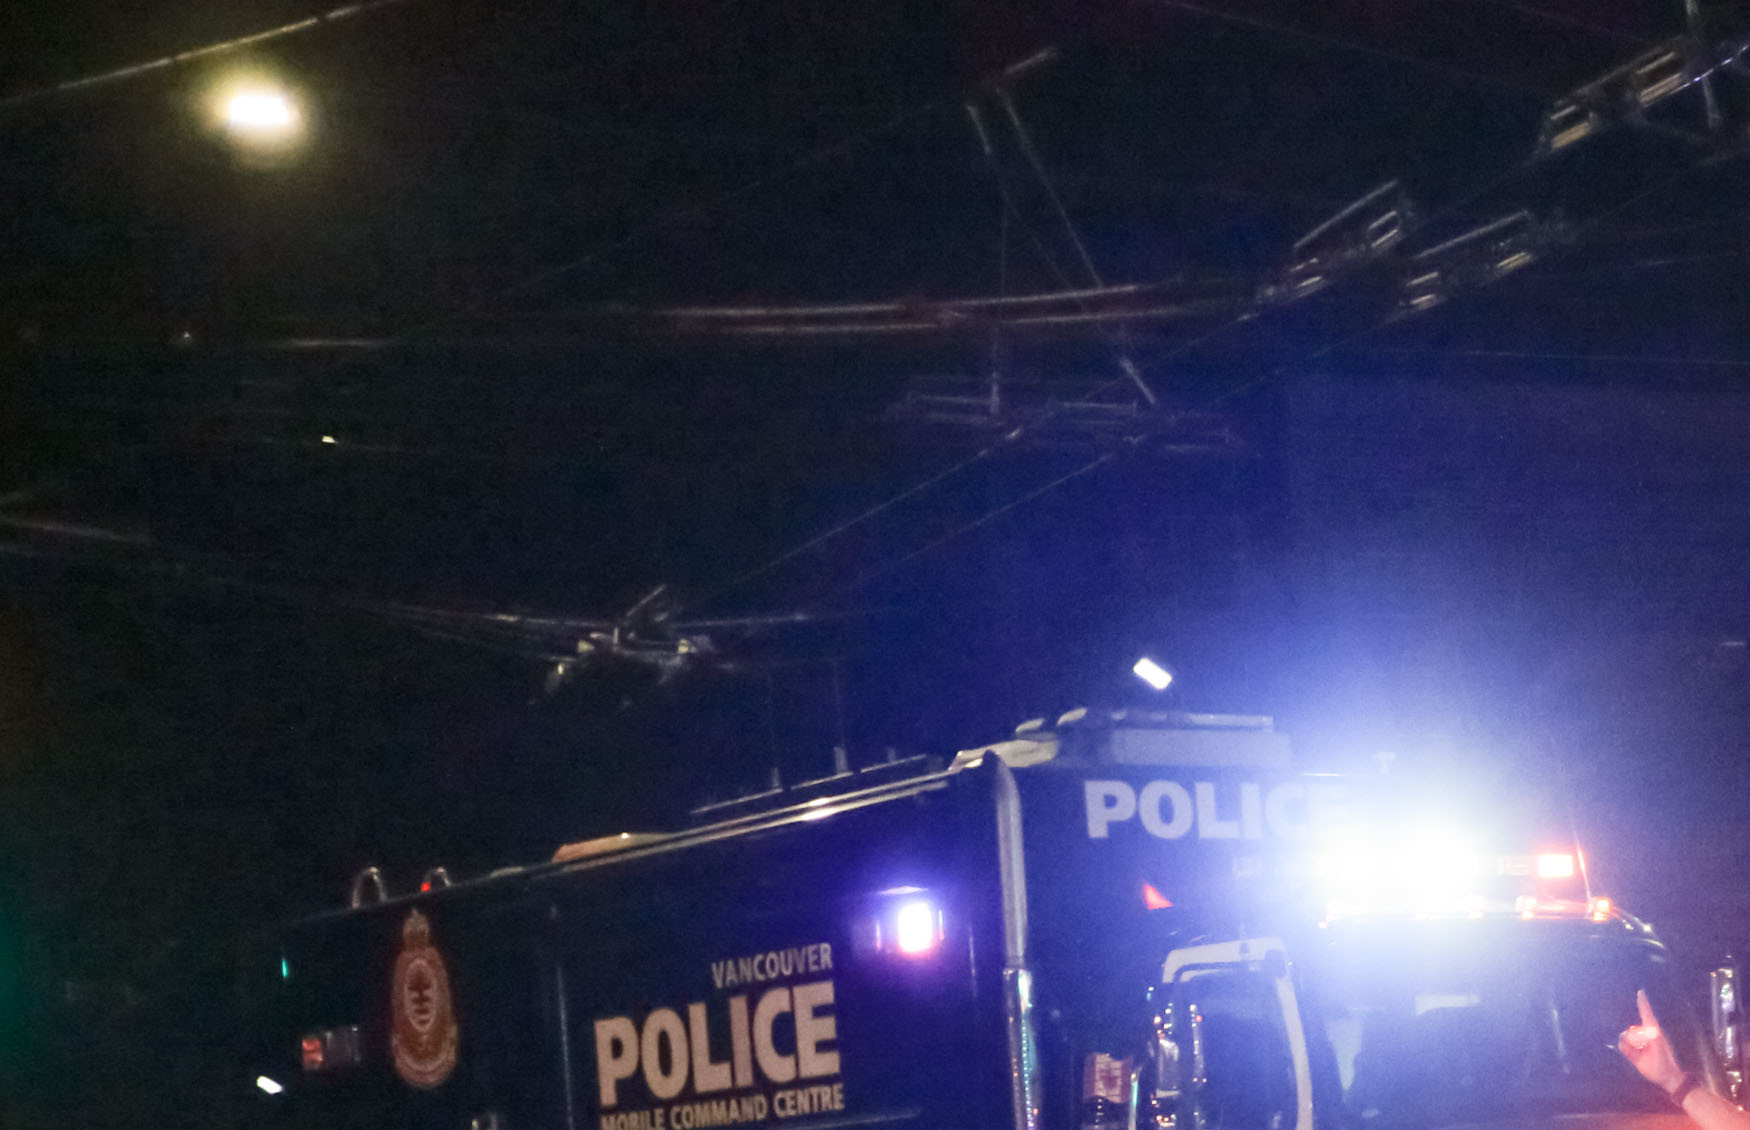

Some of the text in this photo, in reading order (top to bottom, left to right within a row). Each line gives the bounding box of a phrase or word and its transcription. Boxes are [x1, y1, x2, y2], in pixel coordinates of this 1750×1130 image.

[711, 942, 833, 990] VANCOUVER
[594, 980, 840, 1108] POLICE
[773, 1082, 846, 1119] CENTRE
